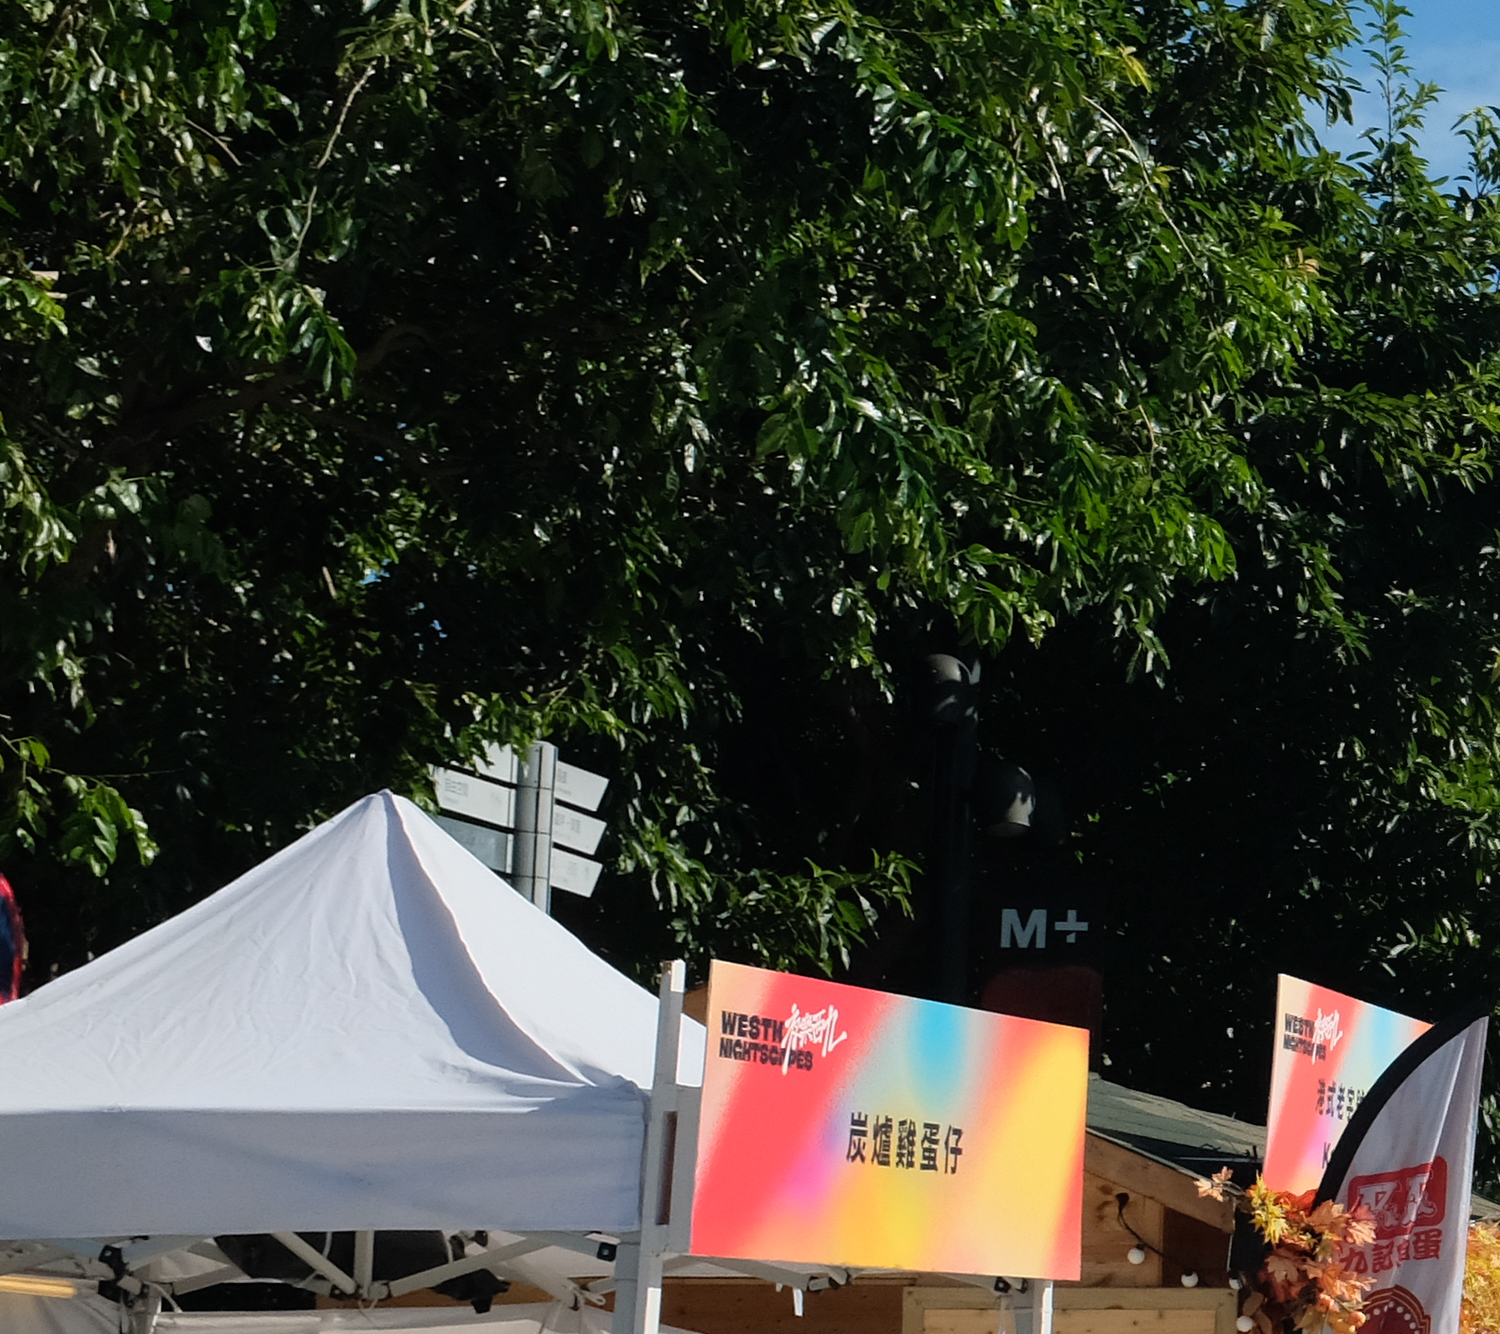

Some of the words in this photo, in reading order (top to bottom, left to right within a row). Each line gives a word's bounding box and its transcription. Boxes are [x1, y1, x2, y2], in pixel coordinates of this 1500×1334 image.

[1000, 908, 1089, 949] M+
[846, 1111, 963, 1175] 炭爐雞蛋仔
